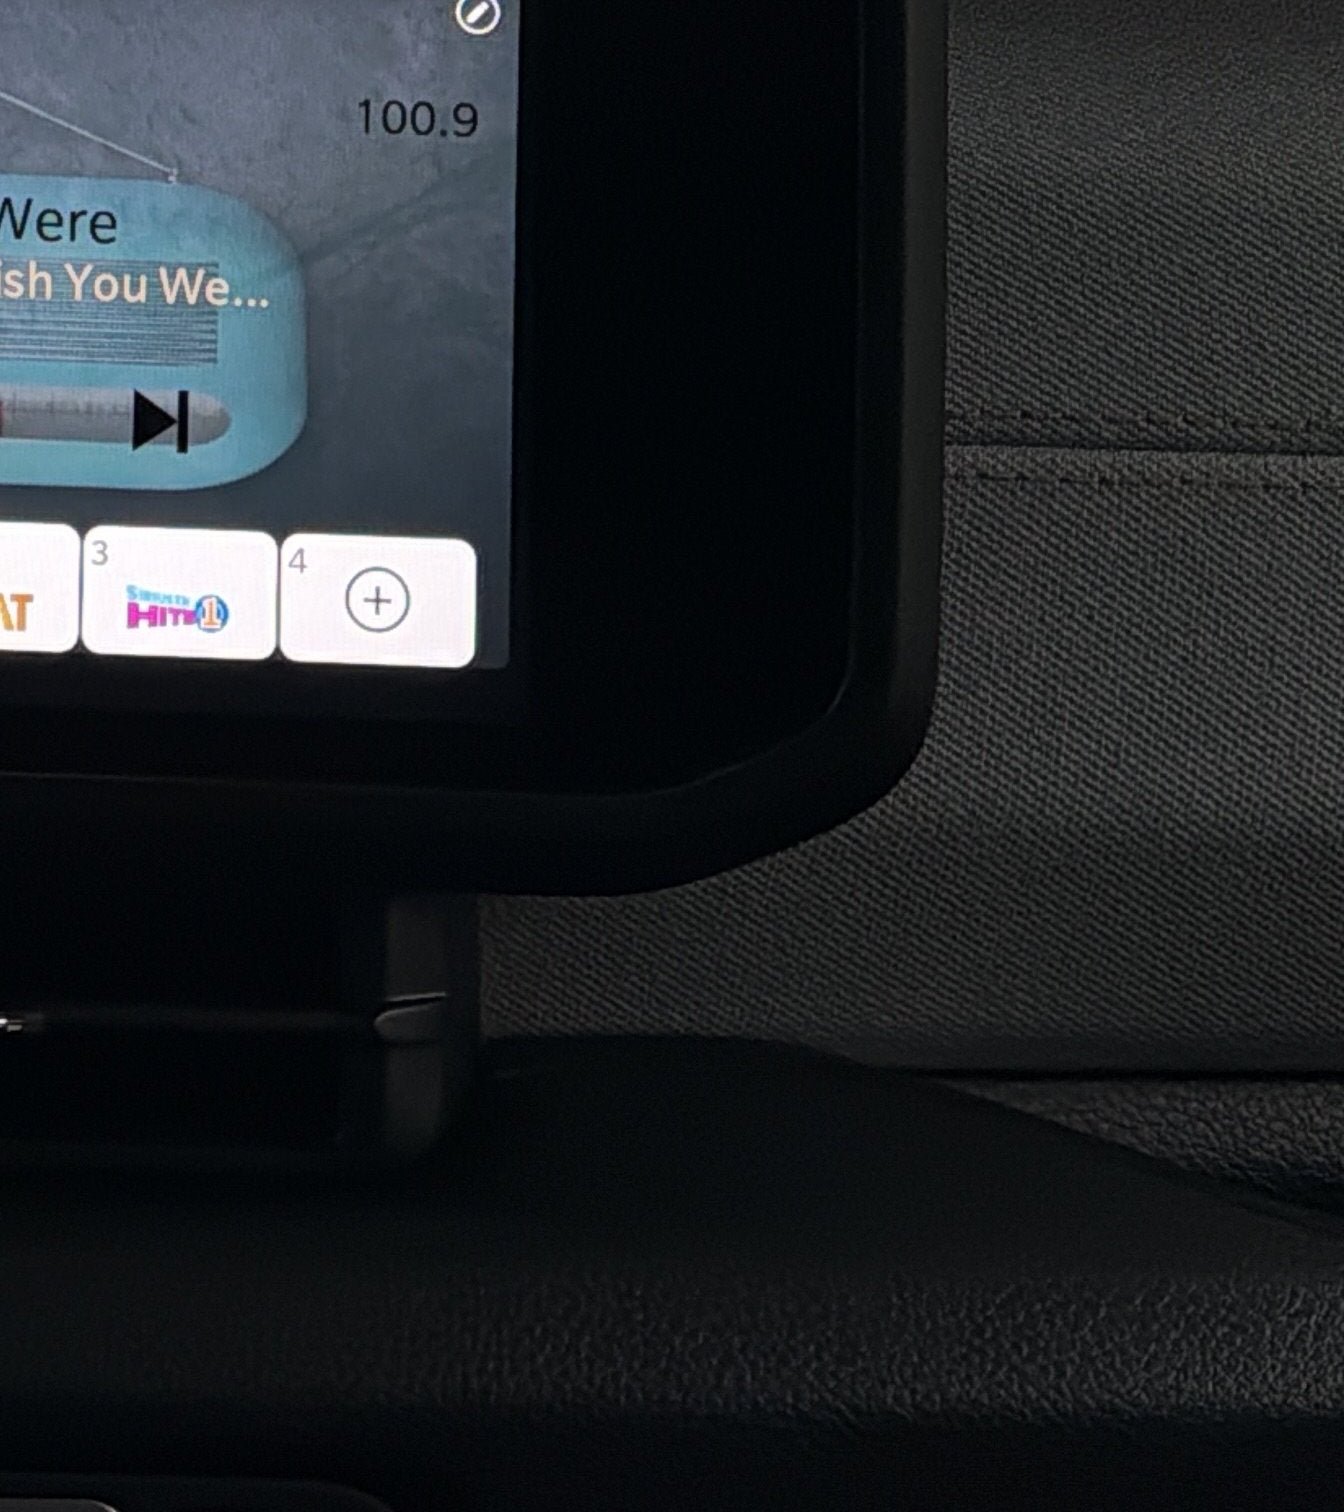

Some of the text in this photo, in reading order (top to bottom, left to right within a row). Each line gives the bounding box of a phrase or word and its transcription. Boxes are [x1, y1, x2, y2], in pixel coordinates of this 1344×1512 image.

[358, 98, 479, 139] 100.9
[64, 262, 148, 305] You
[91, 539, 110, 567] 3
[288, 547, 309, 575] 4
